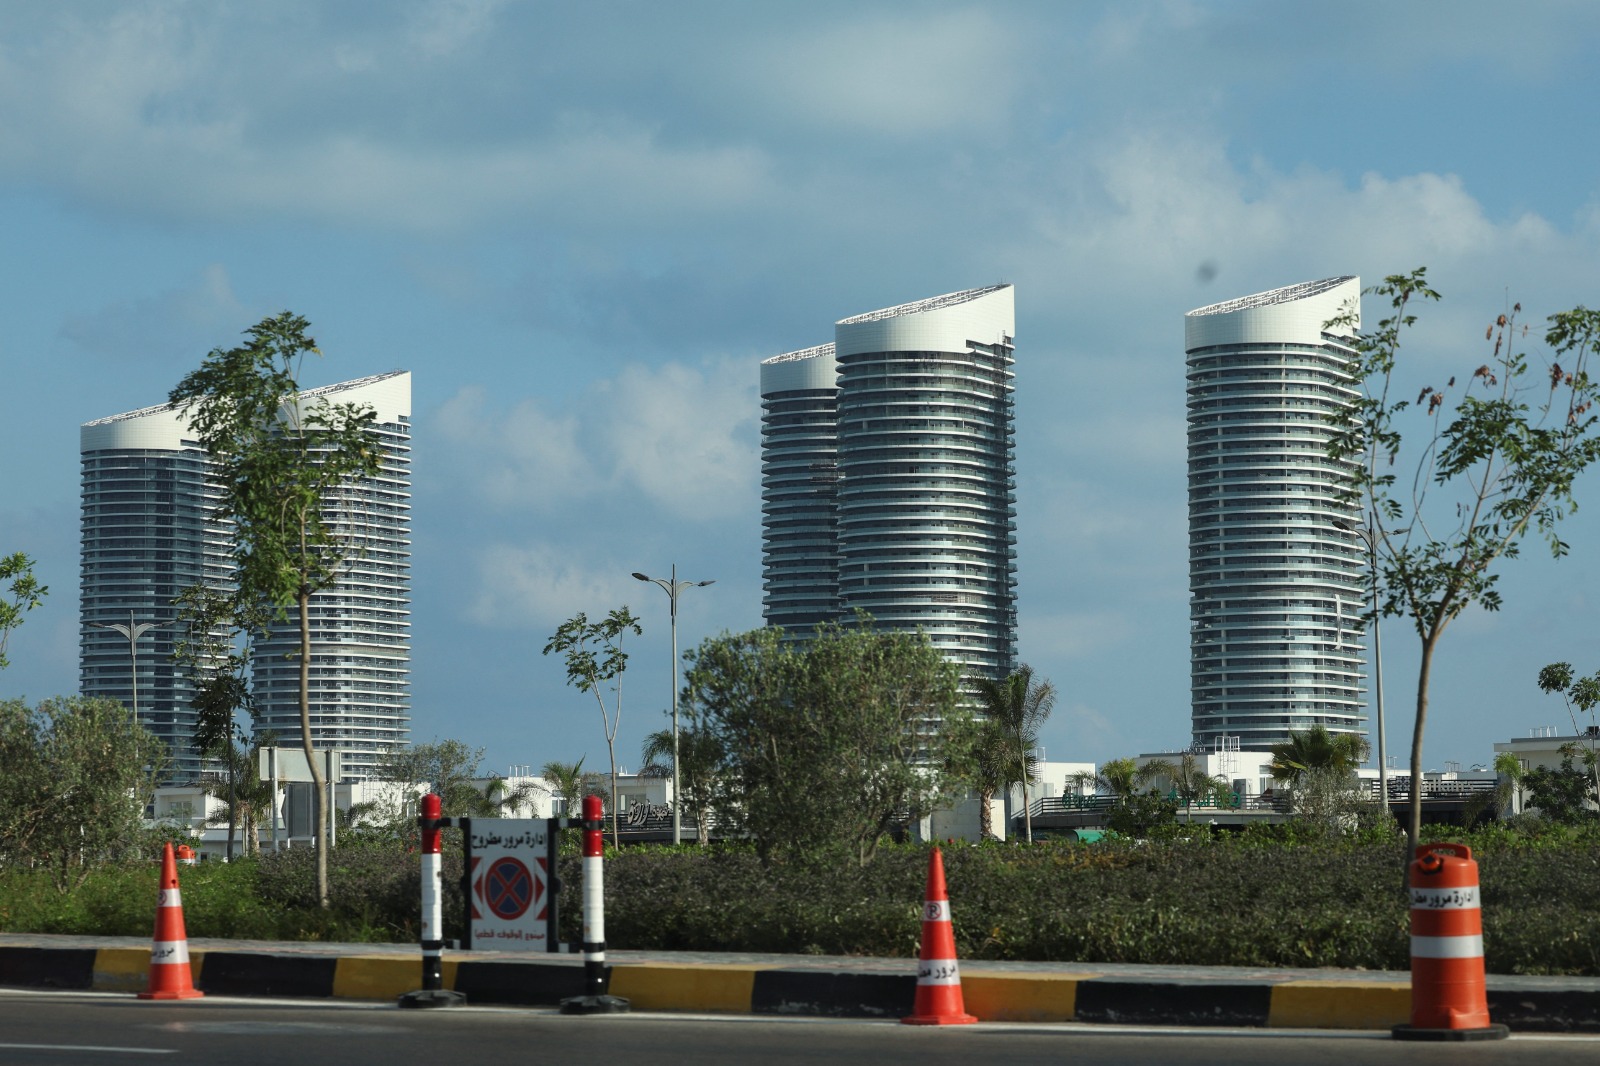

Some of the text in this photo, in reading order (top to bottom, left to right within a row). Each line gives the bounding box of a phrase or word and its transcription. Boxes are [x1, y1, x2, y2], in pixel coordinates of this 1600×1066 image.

[471, 831, 502, 849] مطروح
[502, 835, 524, 849] مرور
[1428, 894, 1452, 908] مرور
[934, 965, 956, 979] مرور
